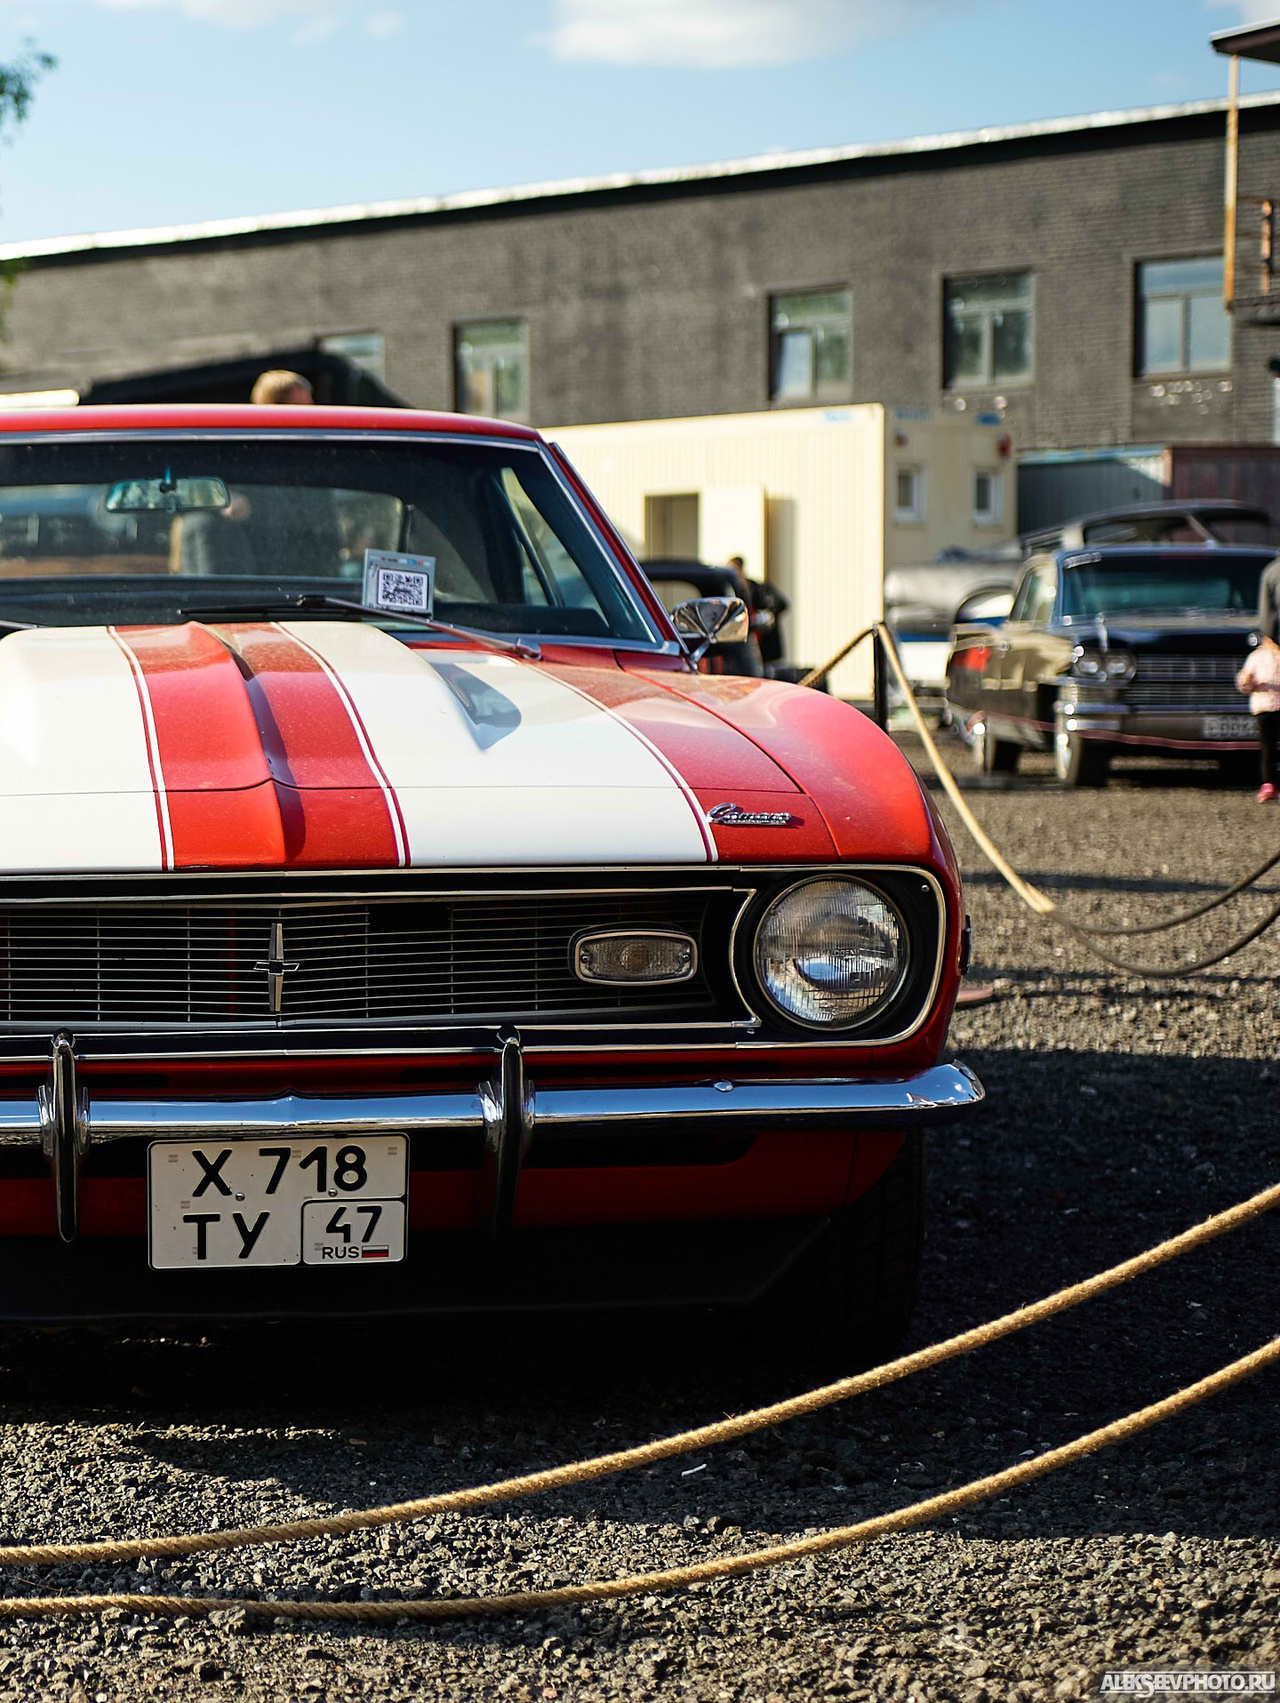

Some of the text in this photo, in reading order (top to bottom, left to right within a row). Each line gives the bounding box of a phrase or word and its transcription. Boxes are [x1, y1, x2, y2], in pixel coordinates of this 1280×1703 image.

[258, 1145, 367, 1195] 718
[326, 1205, 382, 1244] 47
[322, 1245, 360, 1260] RUS
